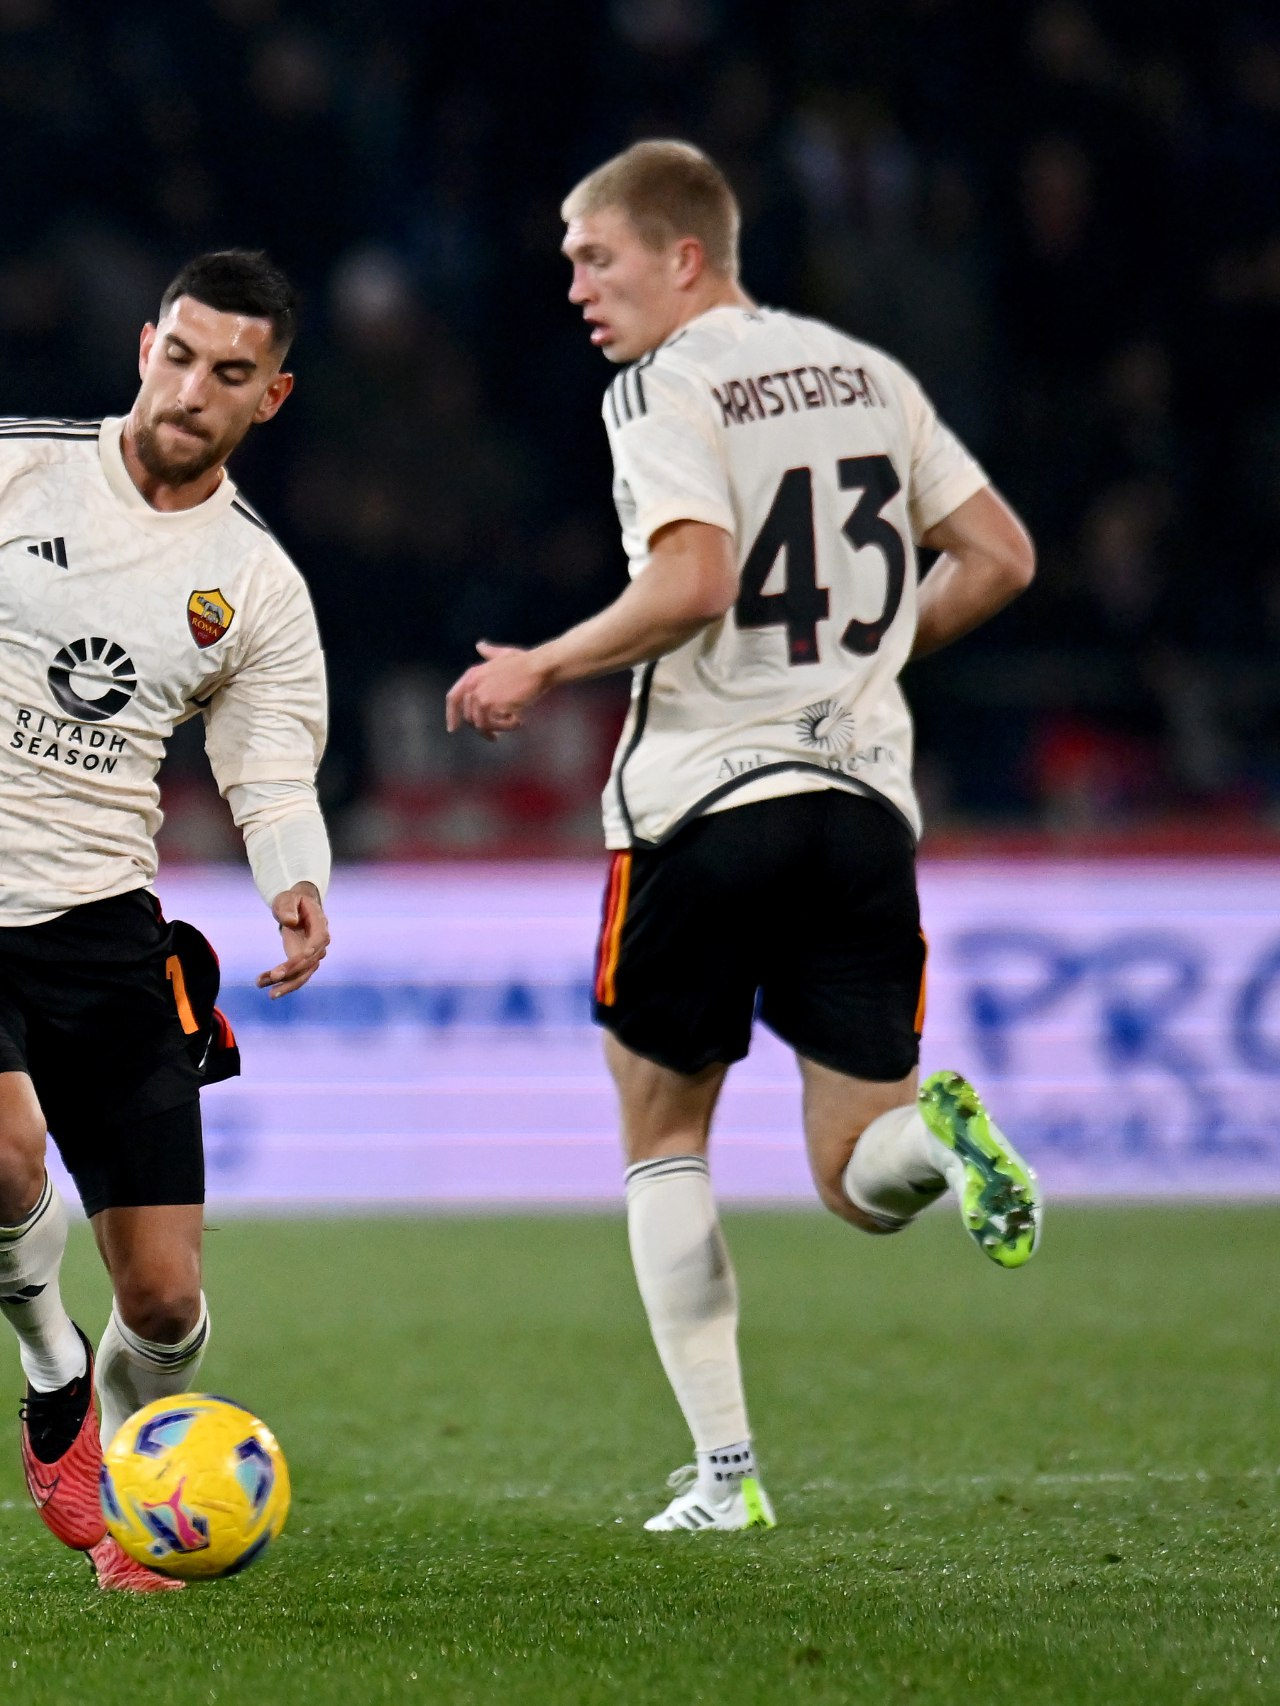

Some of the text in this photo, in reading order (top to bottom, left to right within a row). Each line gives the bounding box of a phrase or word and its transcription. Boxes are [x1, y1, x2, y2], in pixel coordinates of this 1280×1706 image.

[734, 454, 906, 667] 43
[191, 617, 218, 637] ROMA
[10, 731, 118, 774] SEASON
[16, 709, 127, 753] RIYADH
